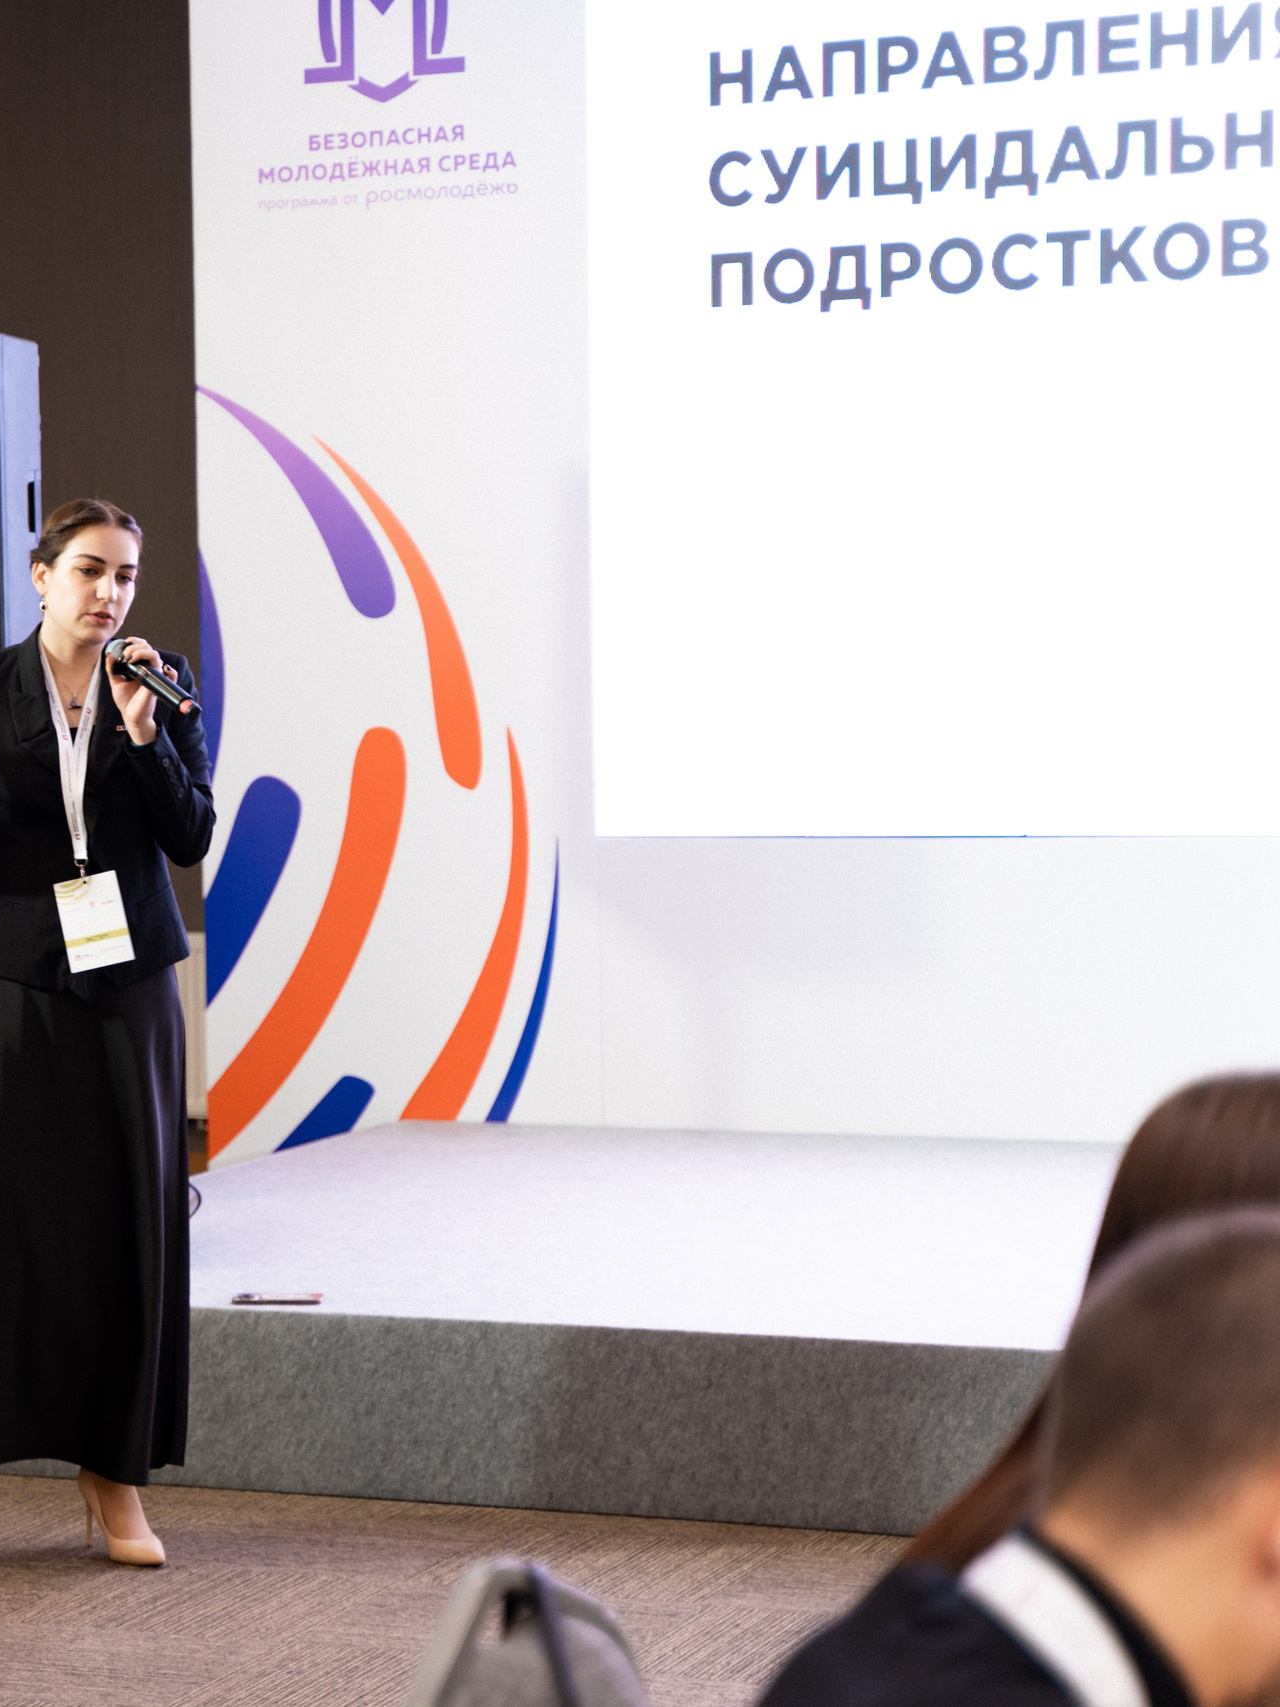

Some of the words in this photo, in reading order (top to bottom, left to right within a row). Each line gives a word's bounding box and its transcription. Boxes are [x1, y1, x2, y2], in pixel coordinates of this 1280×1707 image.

[709, 2, 1280, 107] НАПРАВЛЕНИ
[257, 156, 431, 185] МОЛОДЁЖНАЯ
[437, 150, 517, 173] СРЕДА
[308, 124, 465, 152] БЕЗОПАСНАЯ
[709, 110, 1274, 207] СУИЦИДАЛЬН
[257, 193, 338, 212] программа
[343, 193, 359, 205] от
[711, 218, 1269, 313] ПОДРОСТКОВ
